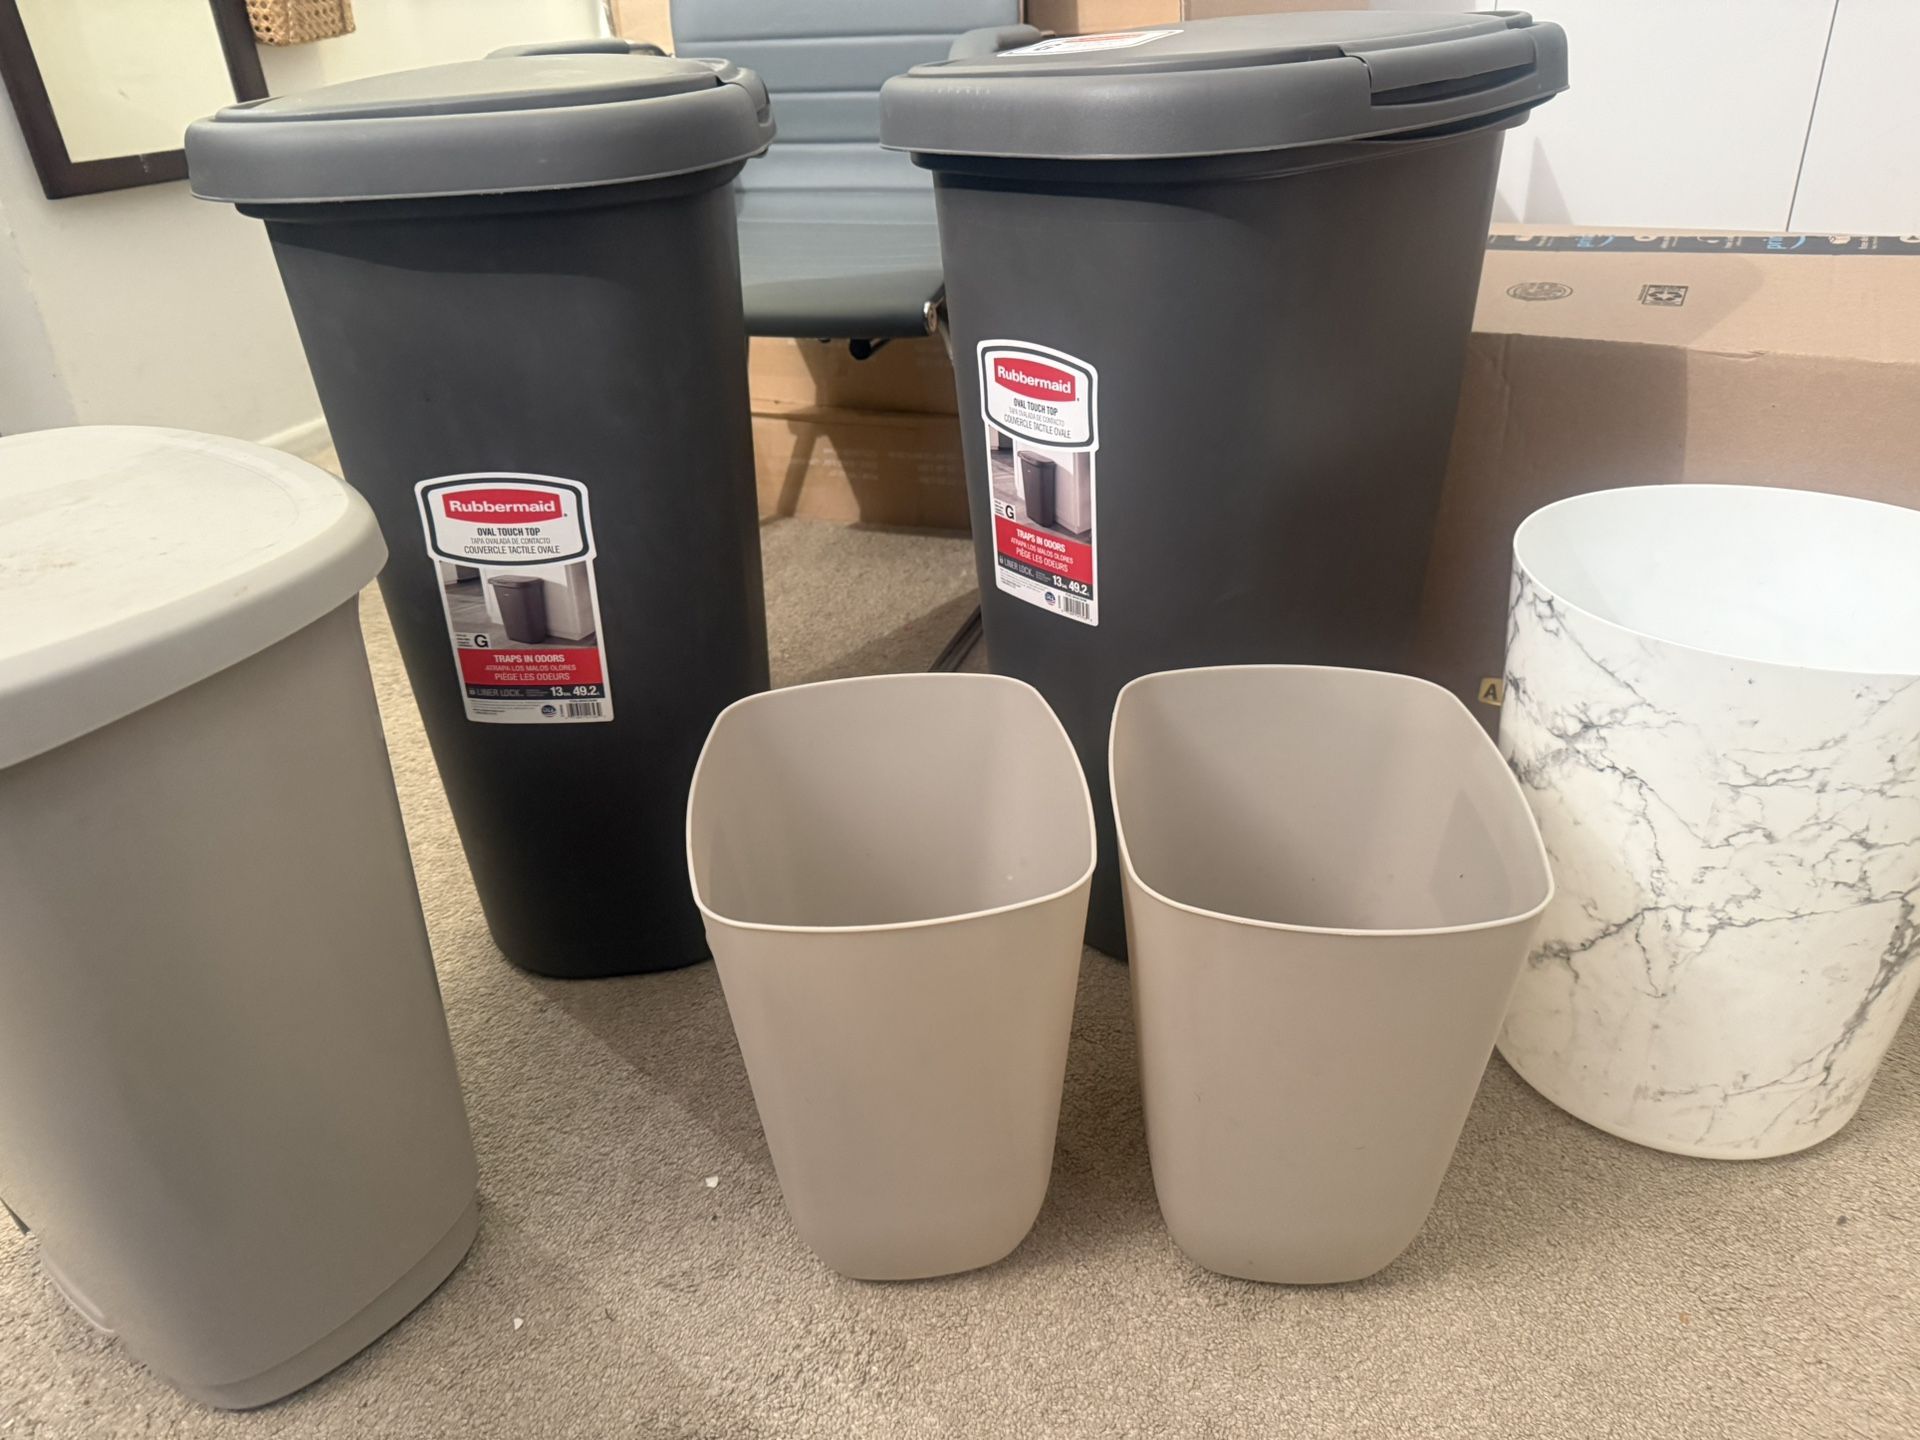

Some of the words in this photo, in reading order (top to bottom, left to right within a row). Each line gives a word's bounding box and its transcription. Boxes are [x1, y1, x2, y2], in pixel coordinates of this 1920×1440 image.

[997, 365, 1072, 394] Rubbermaid
[1013, 398, 1026, 409] OVAL
[1027, 401, 1046, 414] TOUCH
[1046, 405, 1059, 417] TOP
[1004, 414, 1032, 429] COUVERCLE
[1033, 421, 1053, 435] TACTILE
[1054, 427, 1071, 439] OVALE
[449, 500, 556, 512] Rubbermaid
[1005, 505, 1015, 519] G
[477, 528, 495, 536] OVAL
[497, 528, 524, 536] TOUCH
[526, 528, 541, 536] TOP
[1016, 528, 1036, 543] TRAPS
[1036, 536, 1043, 546] IN
[1043, 538, 1066, 553] ODORS
[464, 546, 506, 554] COUVERCLE
[507, 546, 536, 554] TACTILE
[537, 545, 561, 554] OVALE
[1032, 553, 1043, 564] LES
[1043, 557, 1069, 573] ODEURS
[1052, 575, 1062, 588] 13
[1068, 580, 1088, 595] 49.2
[474, 634, 489, 648] G
[493, 654, 522, 663] TRAPS
[523, 654, 534, 663] IN
[535, 654, 565, 663] ODORS
[495, 671, 519, 681] PIÈGE
[520, 673, 535, 681] LES
[536, 672, 570, 681] ODEURS
[550, 686, 564, 697] 13
[572, 685, 597, 696] 49.2
[1484, 683, 1498, 701] A
